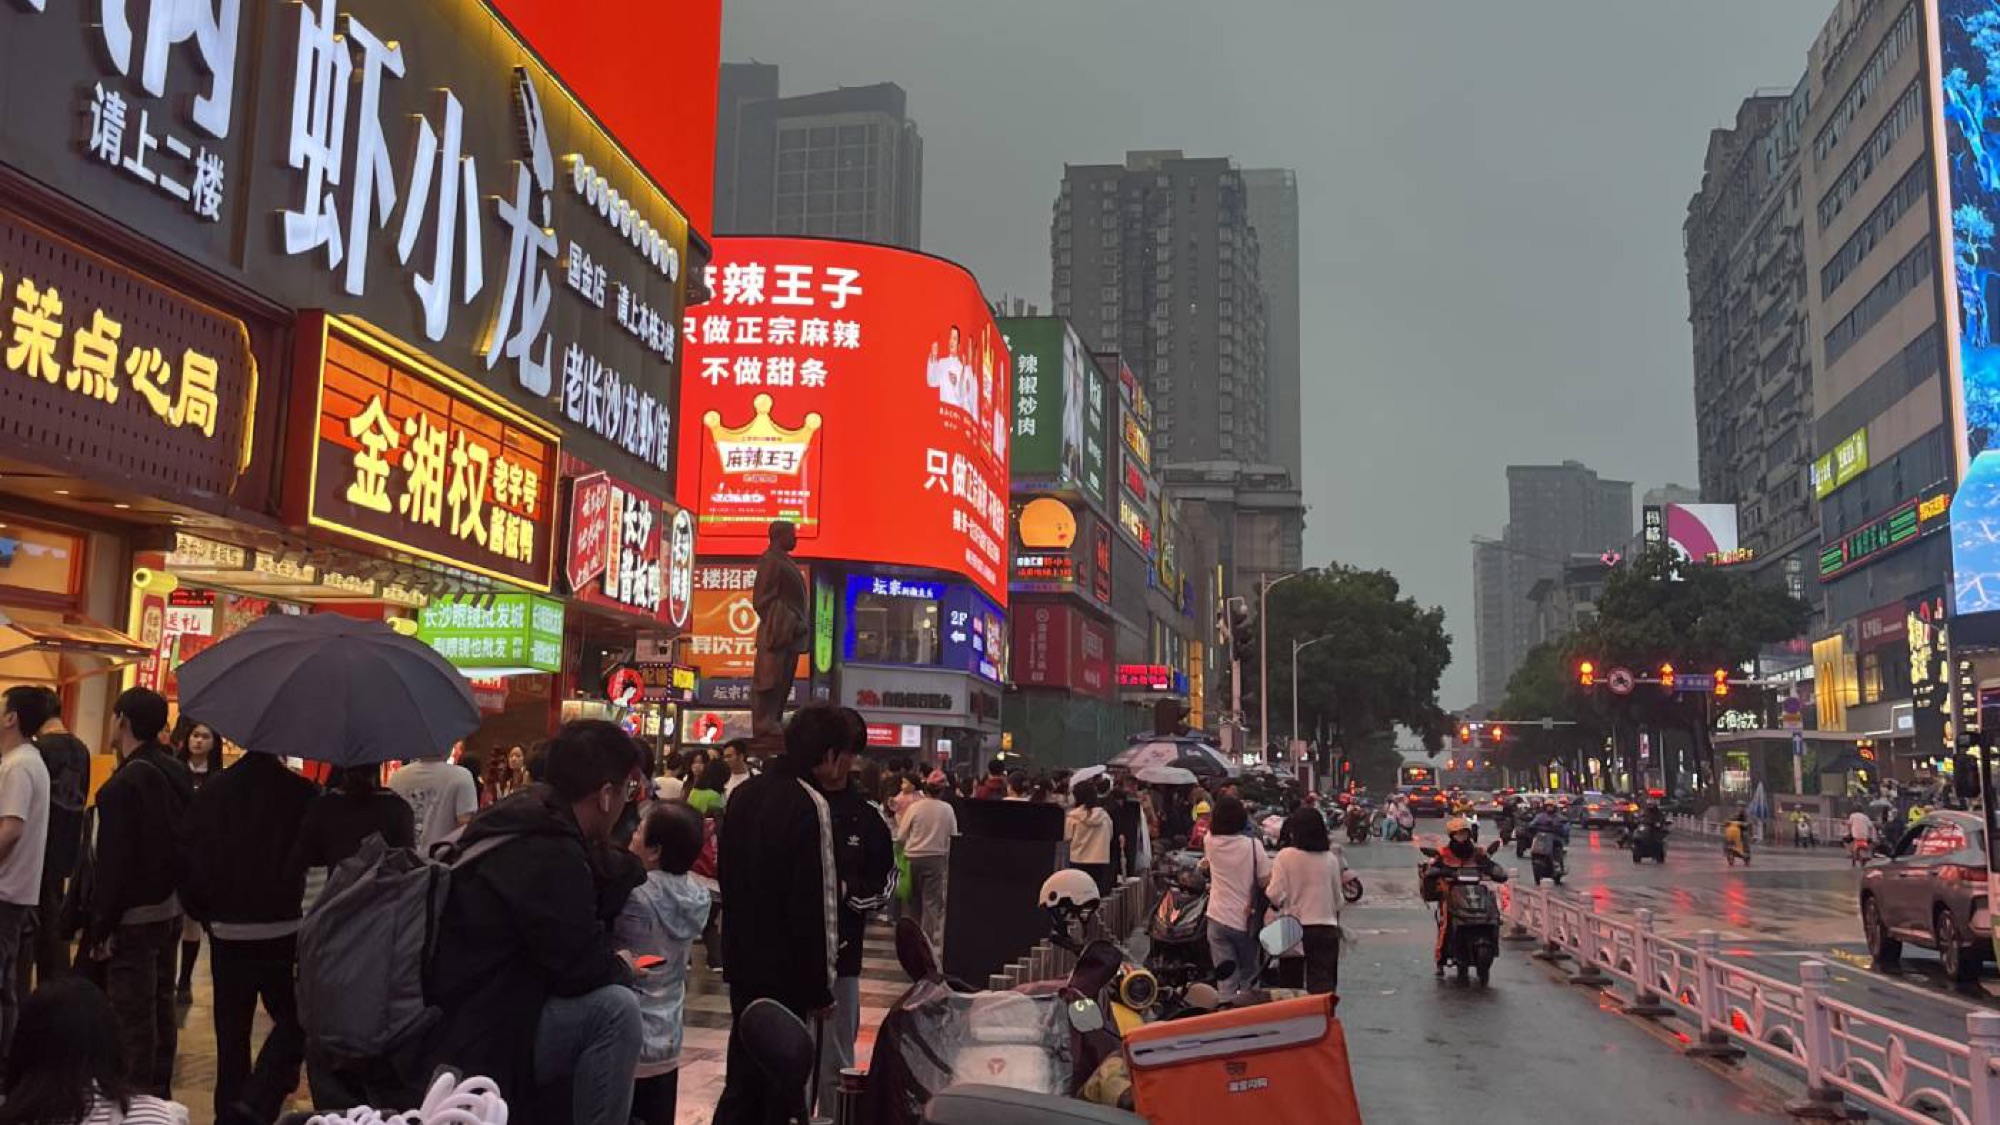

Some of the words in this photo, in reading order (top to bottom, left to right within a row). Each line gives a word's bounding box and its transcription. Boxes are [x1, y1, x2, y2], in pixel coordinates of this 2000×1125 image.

[90, 81, 224, 222] 请上二楼
[567, 240, 607, 309] 国金店
[0, 270, 218, 437] 茉点心局
[701, 357, 828, 387] 不做甜条
[562, 342, 671, 471] 老长沙龙虾馆
[1017, 354, 1037, 436] 辣椒炒肉
[347, 395, 490, 546] 金湘权
[493, 456, 538, 513] 老字号
[726, 446, 798, 470] 麻辣王子
[624, 492, 652, 551] 长沙
[950, 611, 968, 625] 2F
